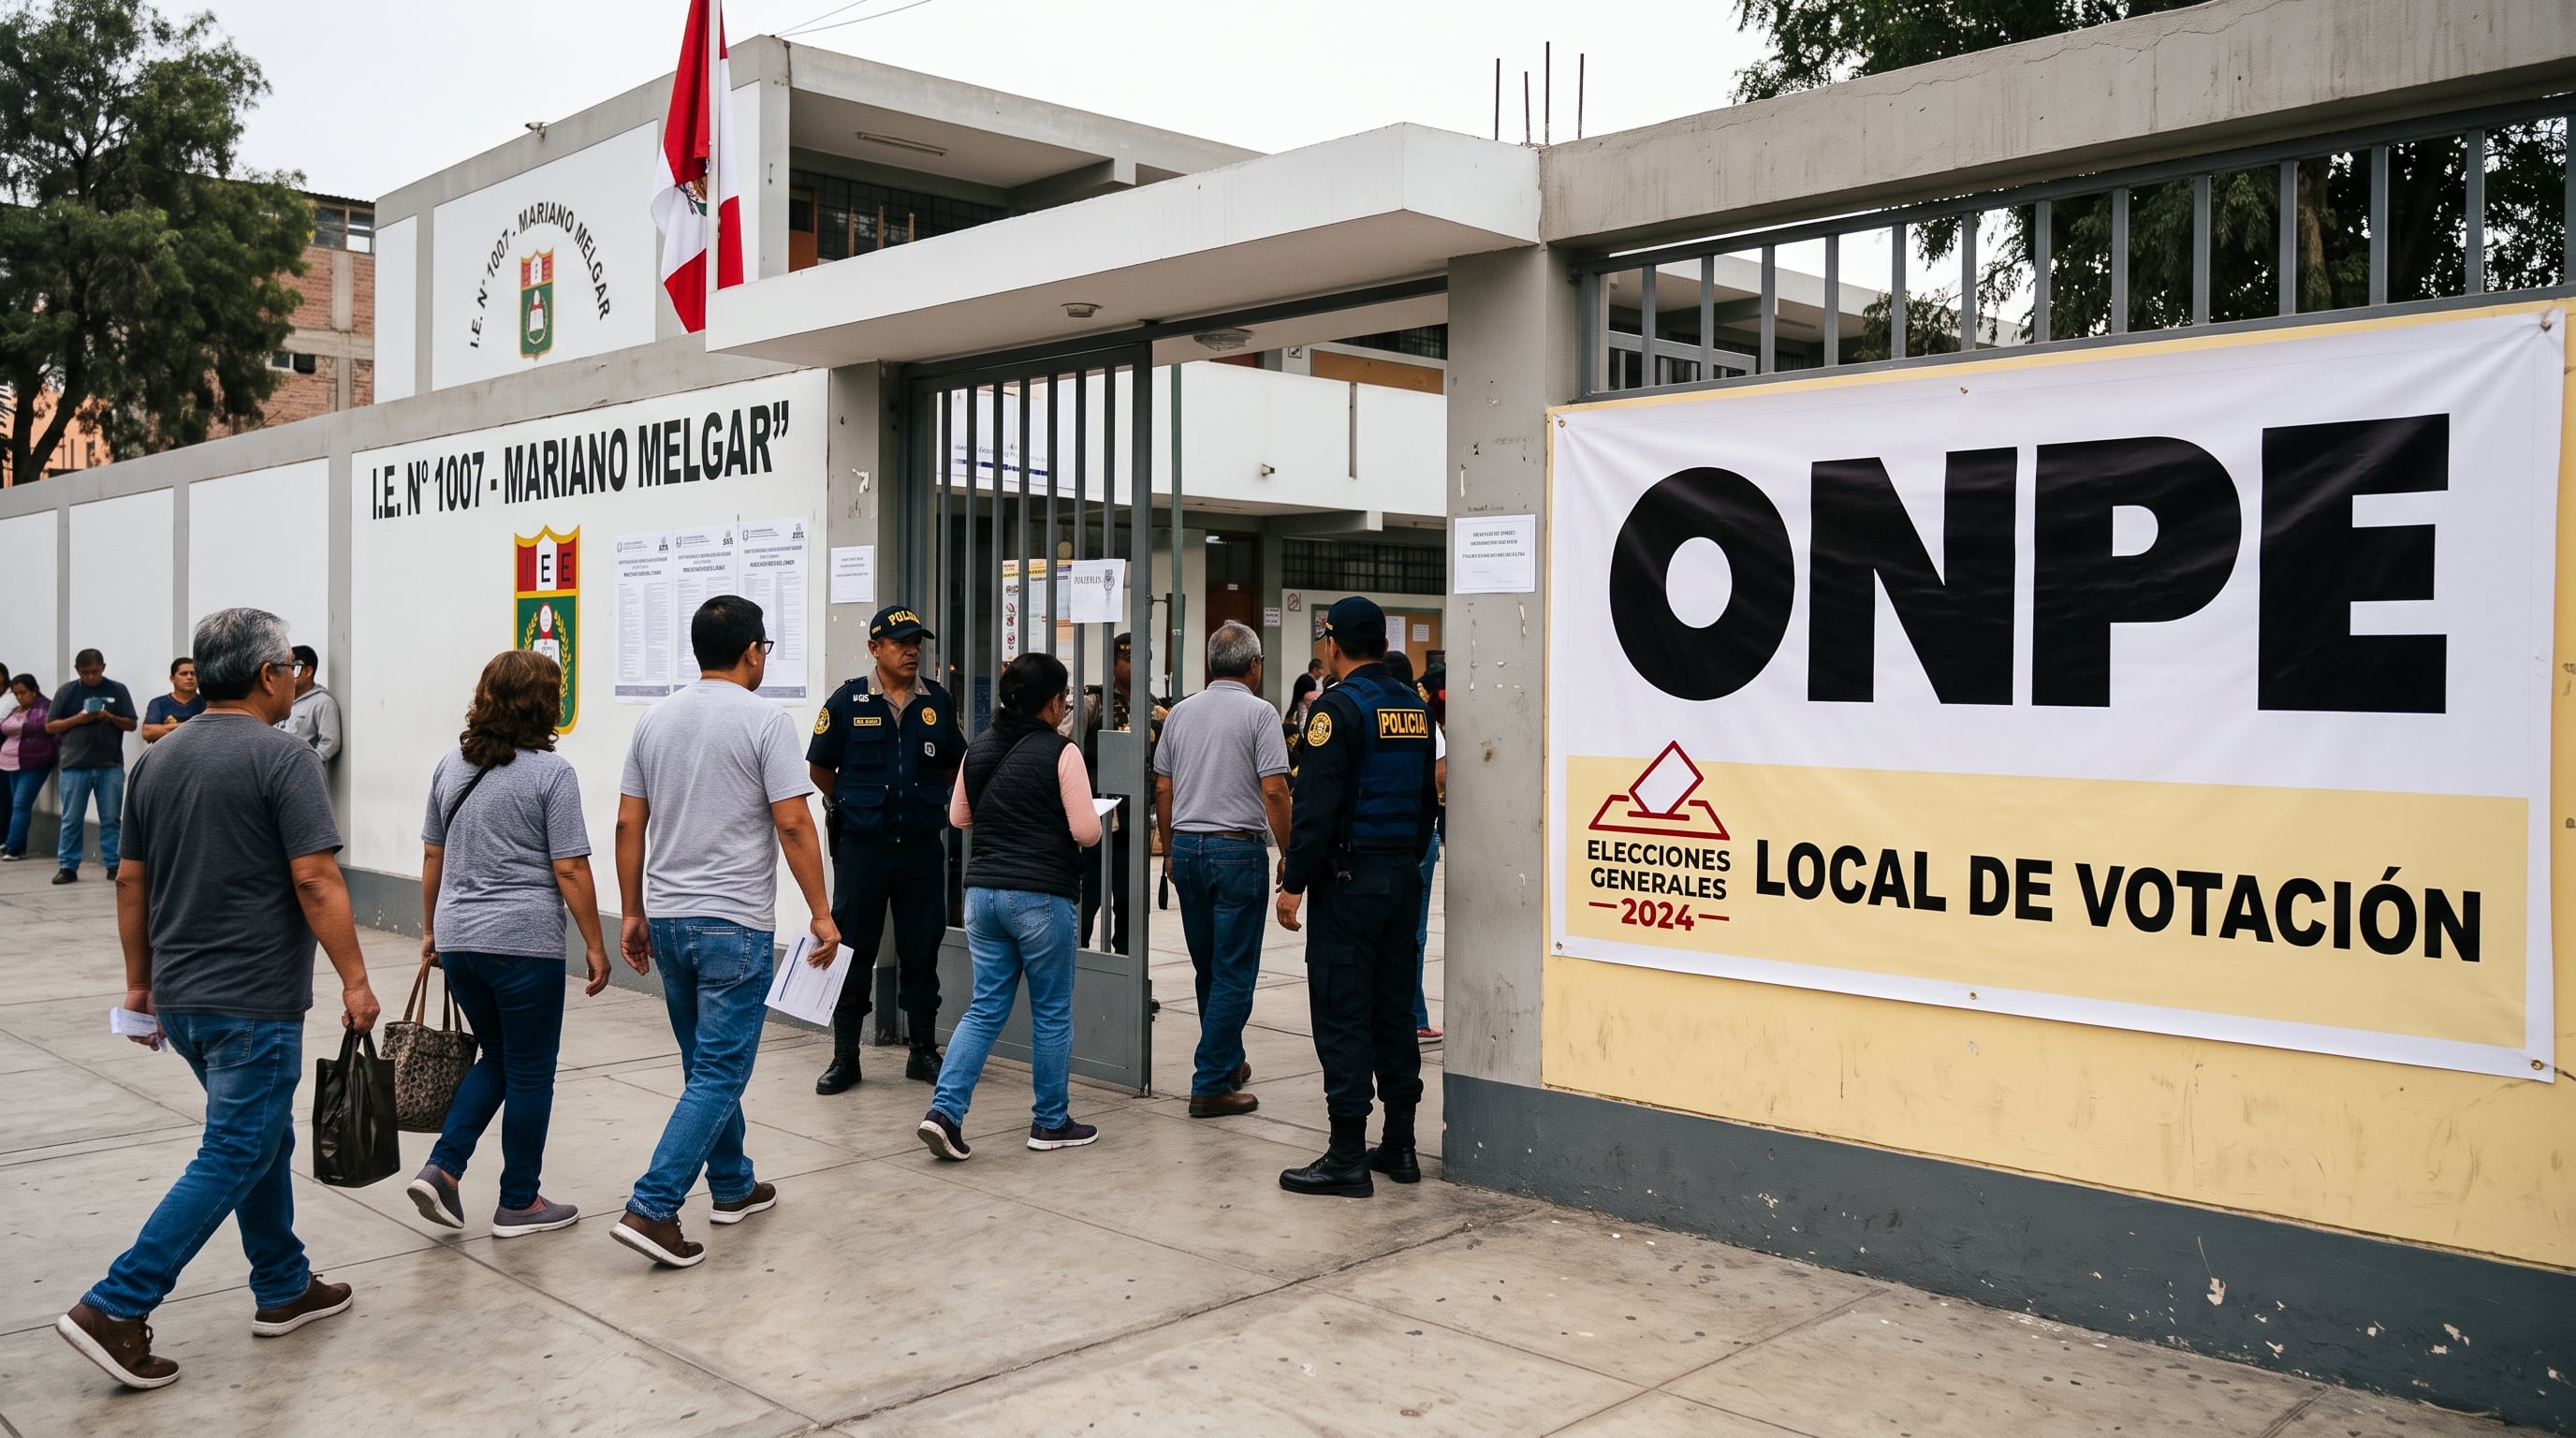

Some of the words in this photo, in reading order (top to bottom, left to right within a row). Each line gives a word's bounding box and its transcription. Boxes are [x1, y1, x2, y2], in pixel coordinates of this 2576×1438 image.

[469, 316, 484, 349] I.E.
[487, 227, 509, 278] 1007
[519, 201, 575, 235] MARIANO
[574, 221, 611, 321] MELGAR
[373, 464, 401, 520] I.E.
[434, 450, 485, 512] 1007
[505, 428, 628, 505] MARIANO
[1609, 413, 2450, 714] ONPE
[1381, 712, 1427, 735] POLICIA
[1588, 839, 1731, 873] ELECCIONES
[1590, 867, 1727, 901] GENERALES
[1621, 897, 1695, 932] 2024
[1756, 839, 1946, 913] LOCAL
[1969, 855, 2053, 922] DE
[2074, 861, 2481, 963] VOTACIÓN
